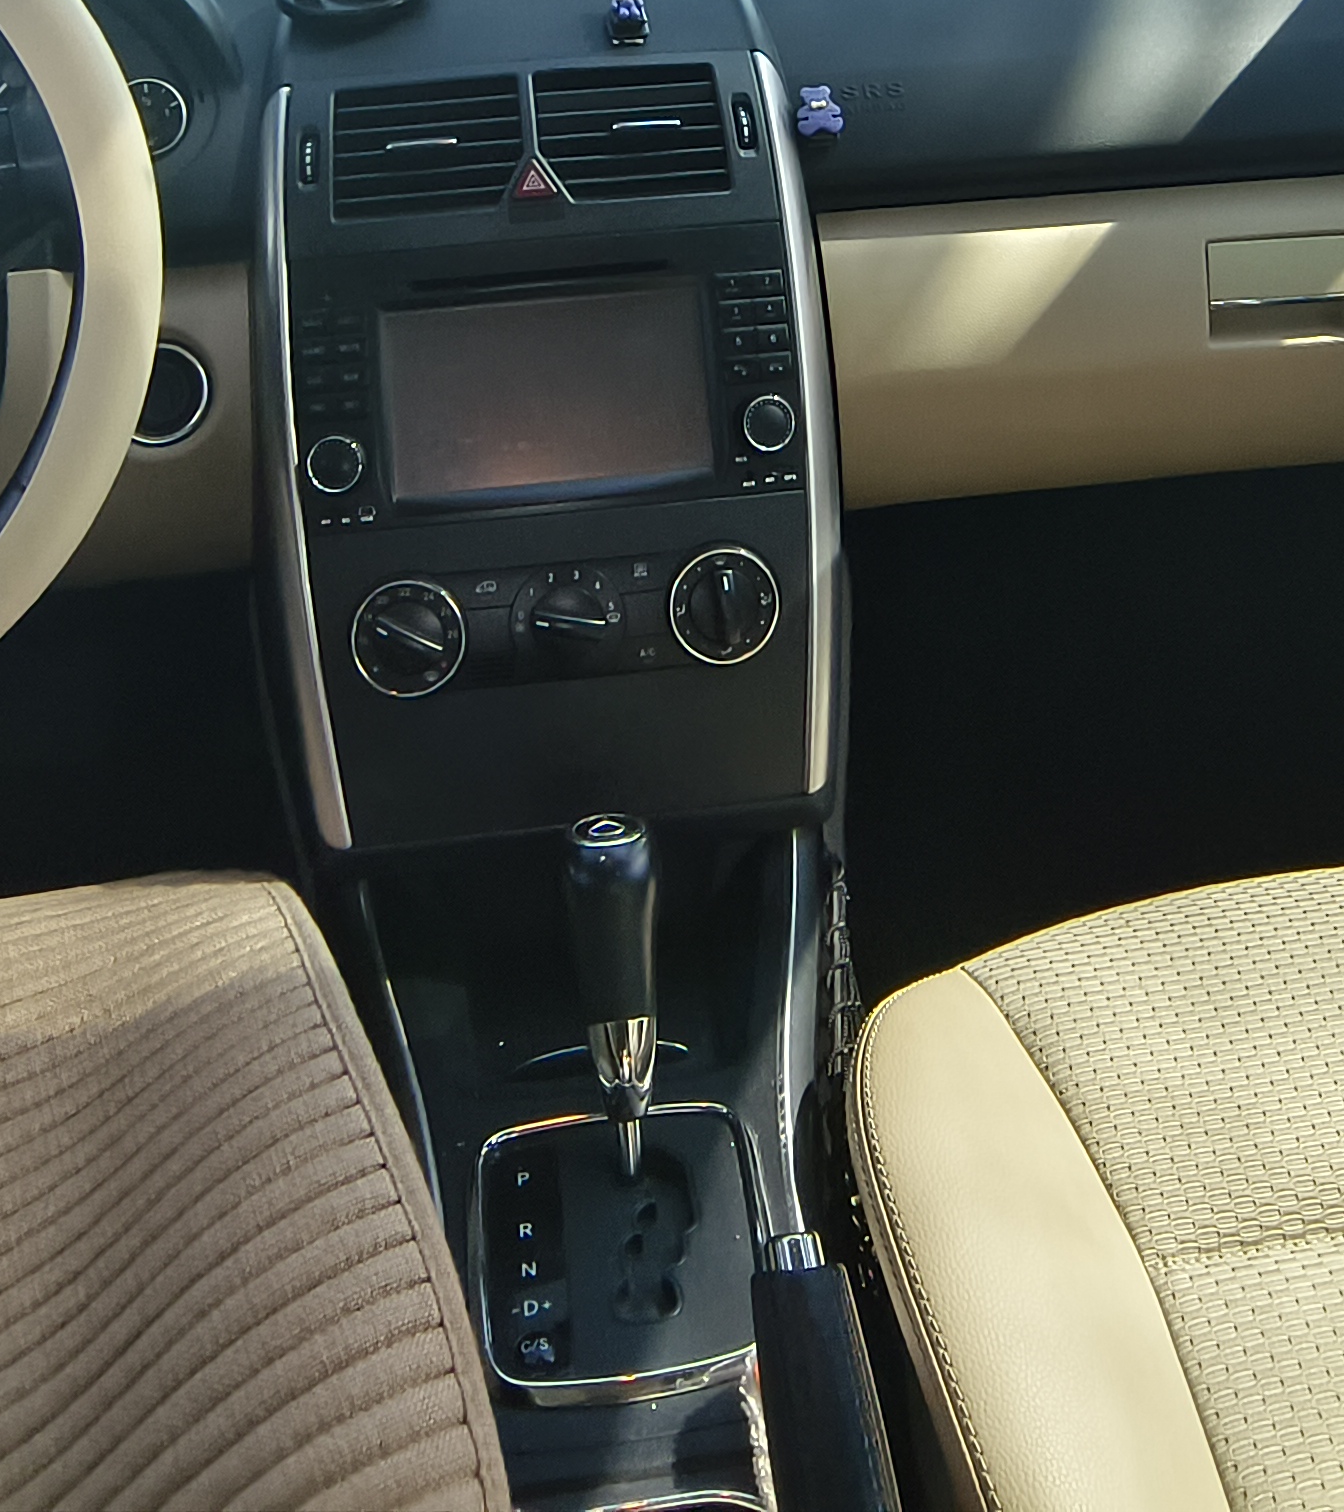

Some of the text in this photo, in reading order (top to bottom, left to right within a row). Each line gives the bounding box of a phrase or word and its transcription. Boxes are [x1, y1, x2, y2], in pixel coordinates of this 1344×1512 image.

[841, 82, 904, 101] SRS
[517, 1171, 530, 1186] P
[519, 1222, 533, 1238] R
[521, 1261, 536, 1277] N
[520, 1337, 549, 1354] C/S
